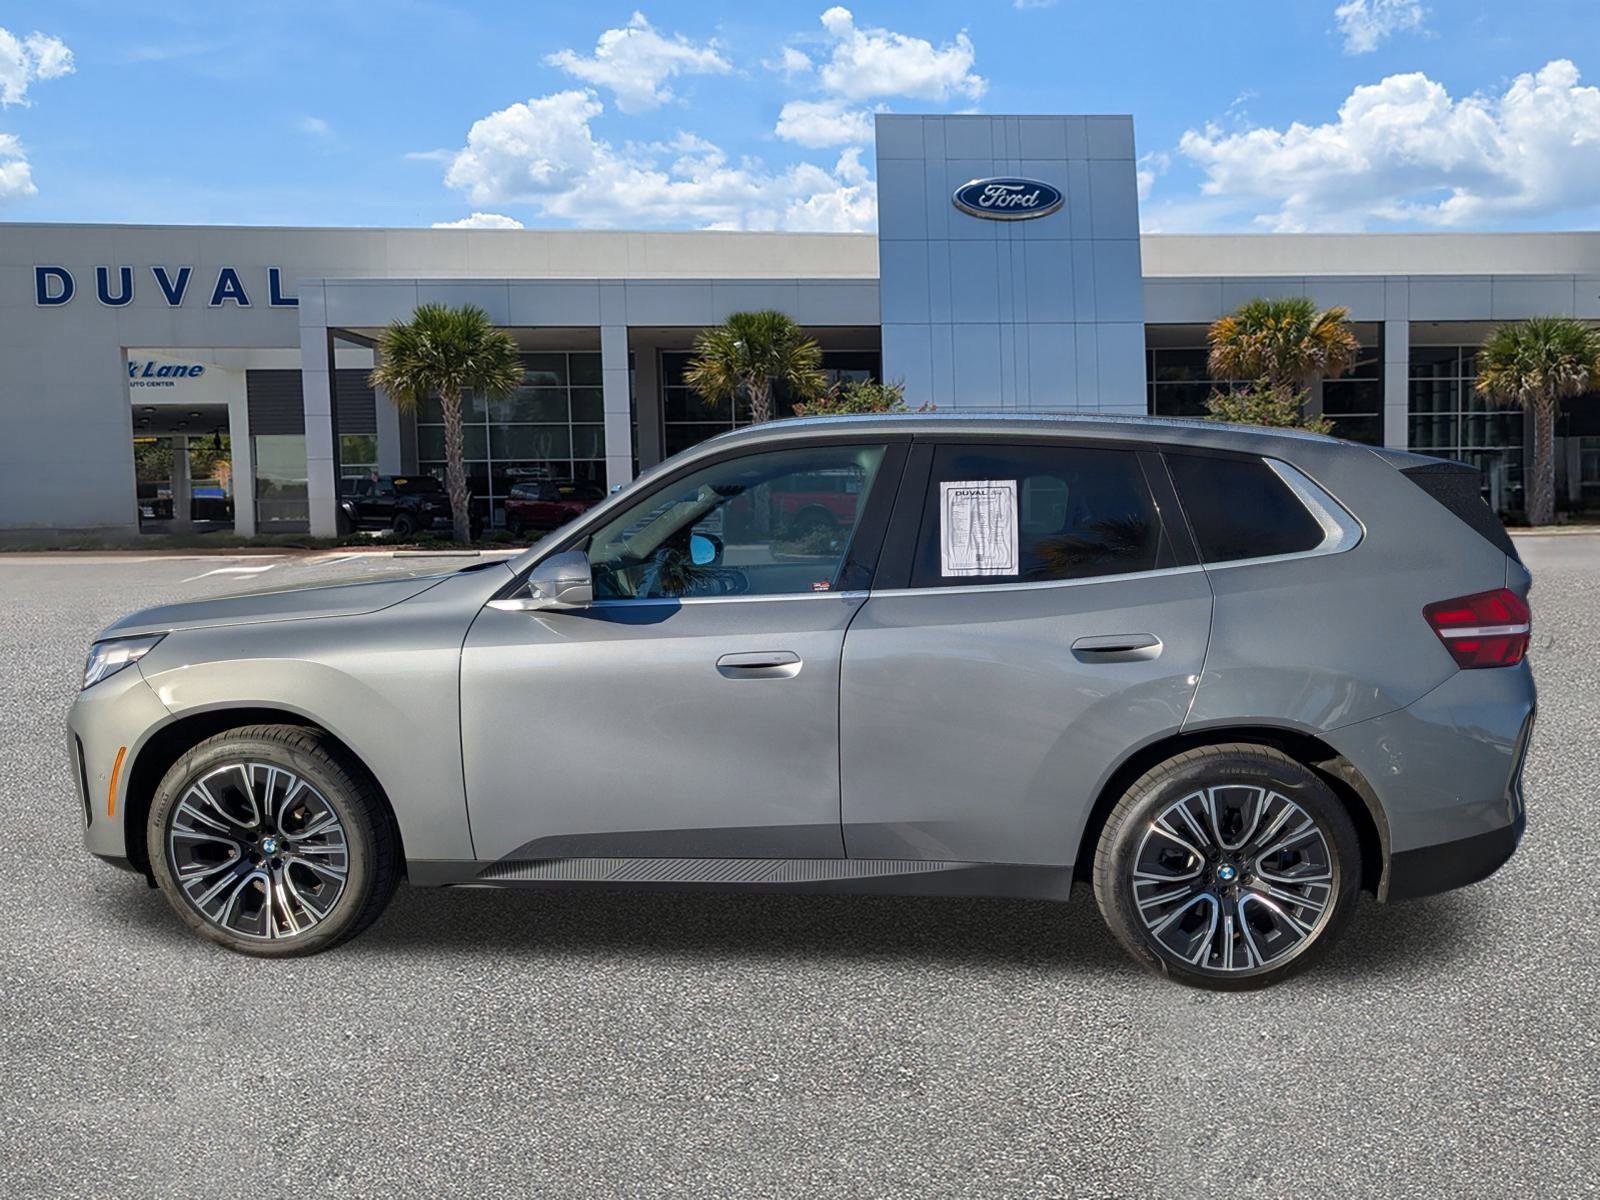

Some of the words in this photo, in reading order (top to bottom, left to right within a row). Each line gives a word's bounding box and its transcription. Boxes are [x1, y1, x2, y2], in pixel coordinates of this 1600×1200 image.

[979, 184, 1040, 207] Ford
[34, 265, 299, 307] DUVAL
[141, 361, 204, 378] Lane
